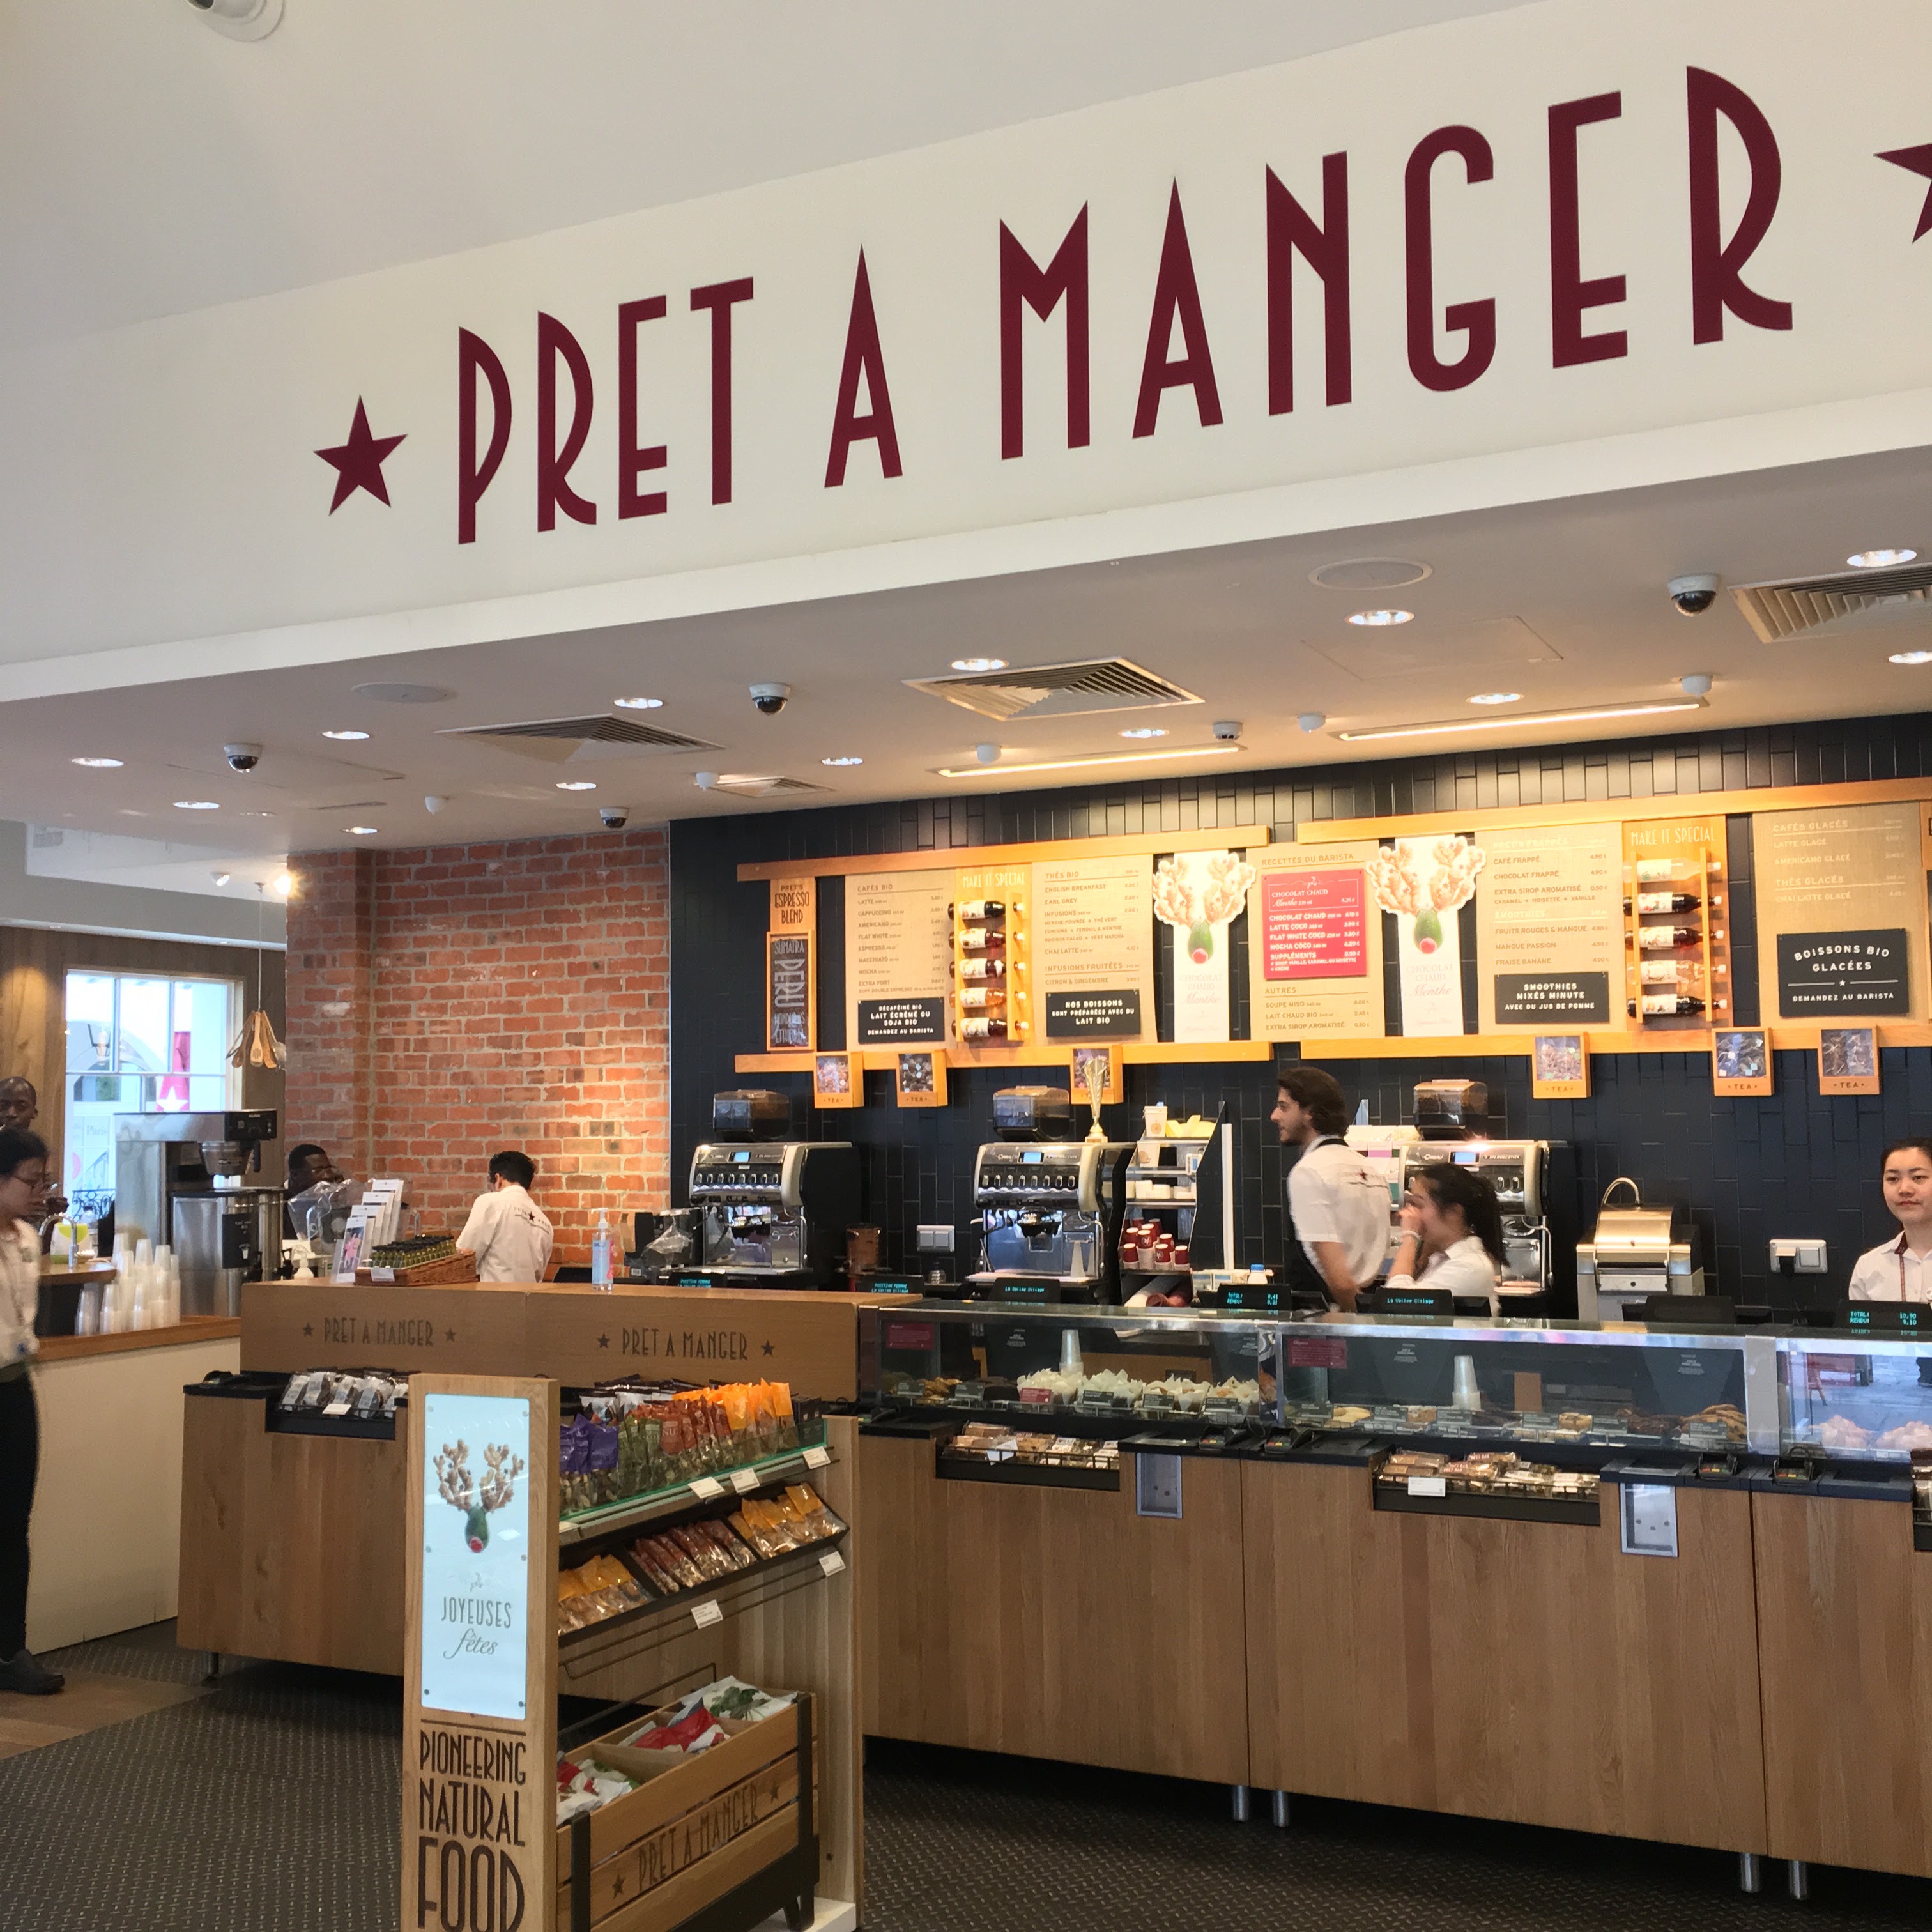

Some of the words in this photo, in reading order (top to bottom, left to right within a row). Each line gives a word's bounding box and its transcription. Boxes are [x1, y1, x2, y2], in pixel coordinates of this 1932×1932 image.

[459, 277, 754, 544] PRET
[824, 243, 903, 488] A
[999, 65, 1793, 460] MANGER
[1773, 822, 1805, 832] CAFÉS
[1810, 820, 1848, 829] GLACÉS
[1631, 829, 1657, 846] MAKE
[1662, 829, 1670, 843] IT
[1675, 825, 1715, 843] SPECIAL
[1774, 840, 1798, 848] LATTE
[1513, 855, 1540, 864] FRAPPÉ
[1775, 856, 1821, 865] AMERICANO
[1825, 854, 1850, 862] GLACÉ
[963, 874, 982, 888] MAKE
[986, 874, 992, 886] IT
[995, 872, 1025, 887] SPECIAL
[1046, 871, 1064, 879] THÉS
[1776, 877, 1801, 887] THÉS
[1805, 875, 1844, 885] GLACÉS
[1541, 884, 1581, 893] AROMATISÉ
[774, 892, 809, 908] ESPRESSO
[1273, 898, 1298, 907] Menthe
[781, 909, 803, 924] BLEND
[1494, 910, 1545, 919] SMOOTHIES
[774, 940, 804, 954] SUMATRA
[1794, 945, 1860, 961] BOISSONS
[1867, 946, 1889, 958] BIO
[1271, 952, 1316, 960] SUPPLÉMENTS
[1407, 964, 1453, 973] CHOCOLAT
[1812, 960, 1871, 972] GLACÉES
[774, 959, 805, 1008] PERU
[1524, 983, 1577, 991] SMOOTHIES
[1517, 991, 1545, 1000] MIXÉS
[324, 1317, 356, 1344] PRET
[362, 1320, 370, 1344] A
[376, 1319, 433, 1347] MANGER
[622, 1328, 659, 1356] PRET
[666, 1332, 675, 1356] A
[682, 1331, 748, 1360] MANGER
[441, 1597, 512, 1628] JOYEUSES
[443, 1628, 497, 1659] fêtes
[420, 1729, 526, 1786] PIONEERING
[419, 1778, 525, 1847] NATURAL
[638, 1828, 677, 1890] PRET
[684, 1826, 692, 1864] A
[700, 1782, 758, 1851] MANGER
[418, 1836, 525, 1932] FOOD
